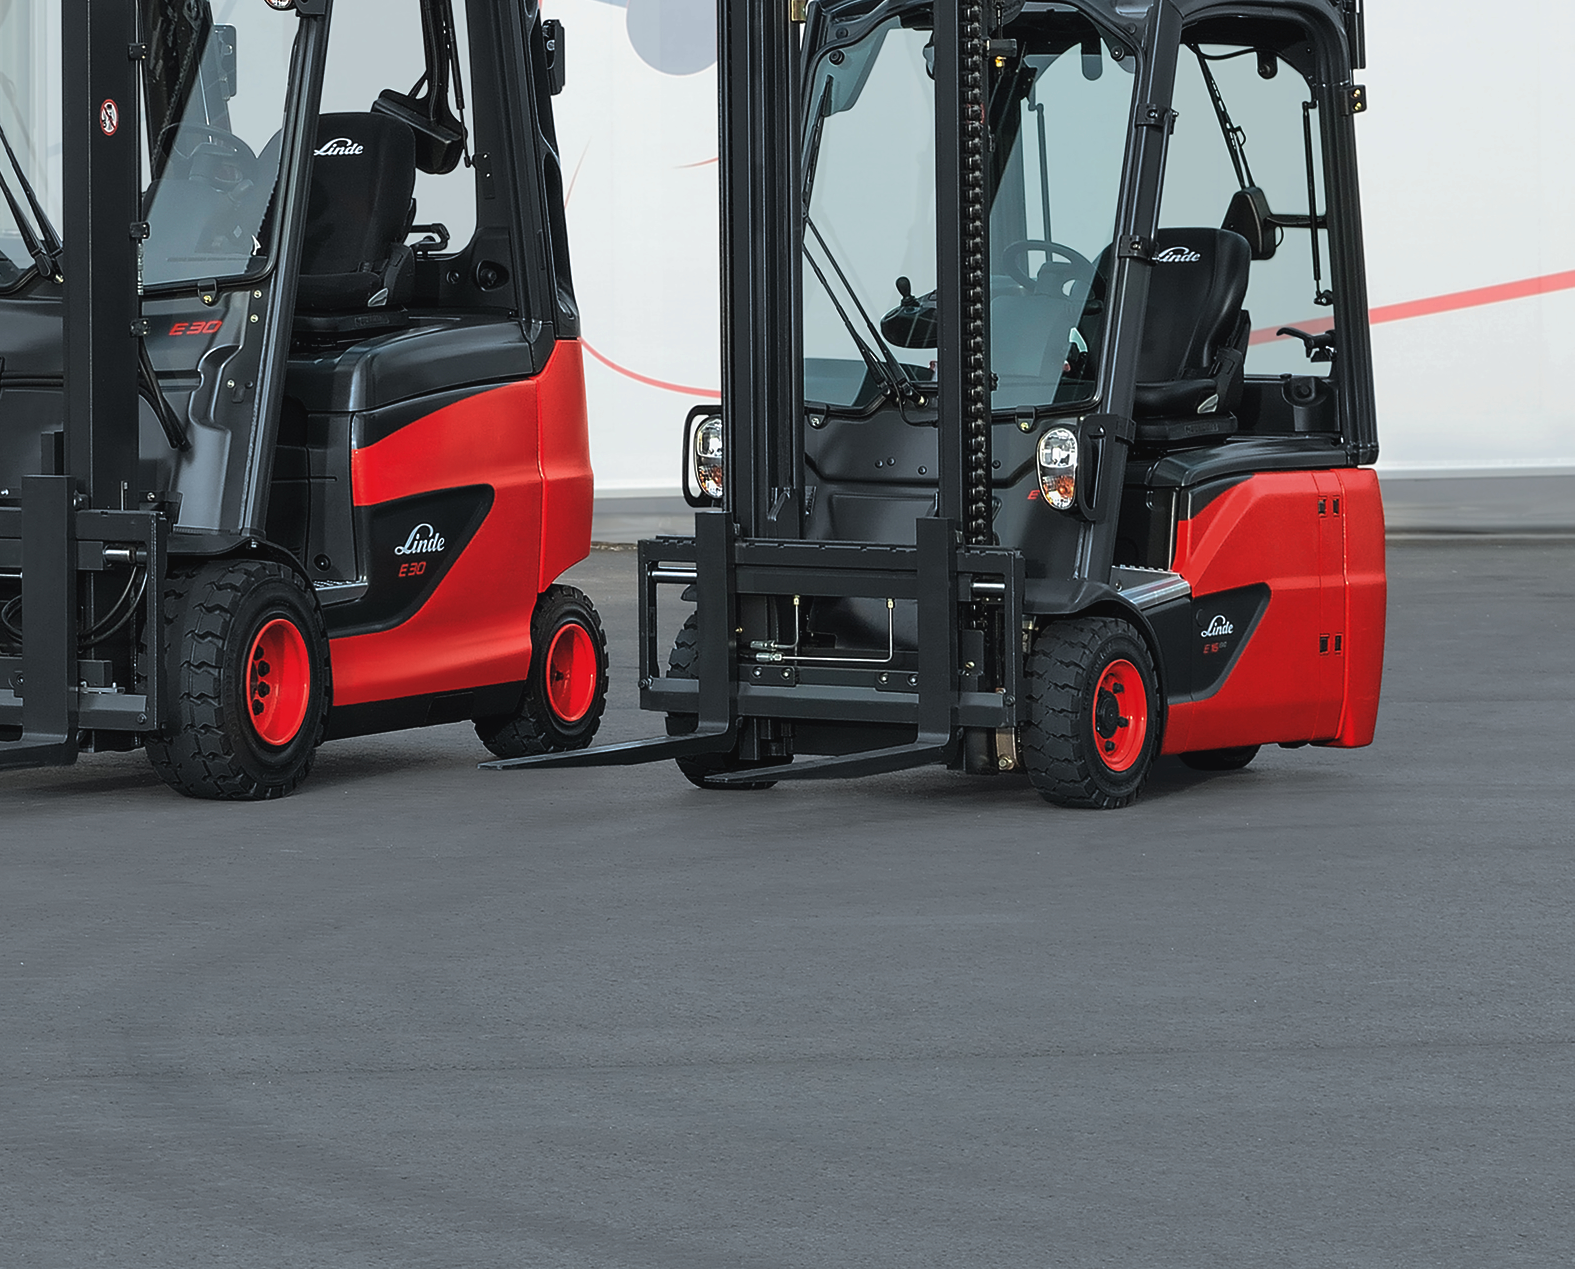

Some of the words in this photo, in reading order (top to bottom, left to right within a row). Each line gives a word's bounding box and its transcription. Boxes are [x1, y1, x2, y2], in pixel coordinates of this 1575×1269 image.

[313, 137, 364, 156] Linde
[1151, 246, 1201, 263] Linde
[394, 523, 445, 555] Linde
[1200, 614, 1235, 638] Linde
